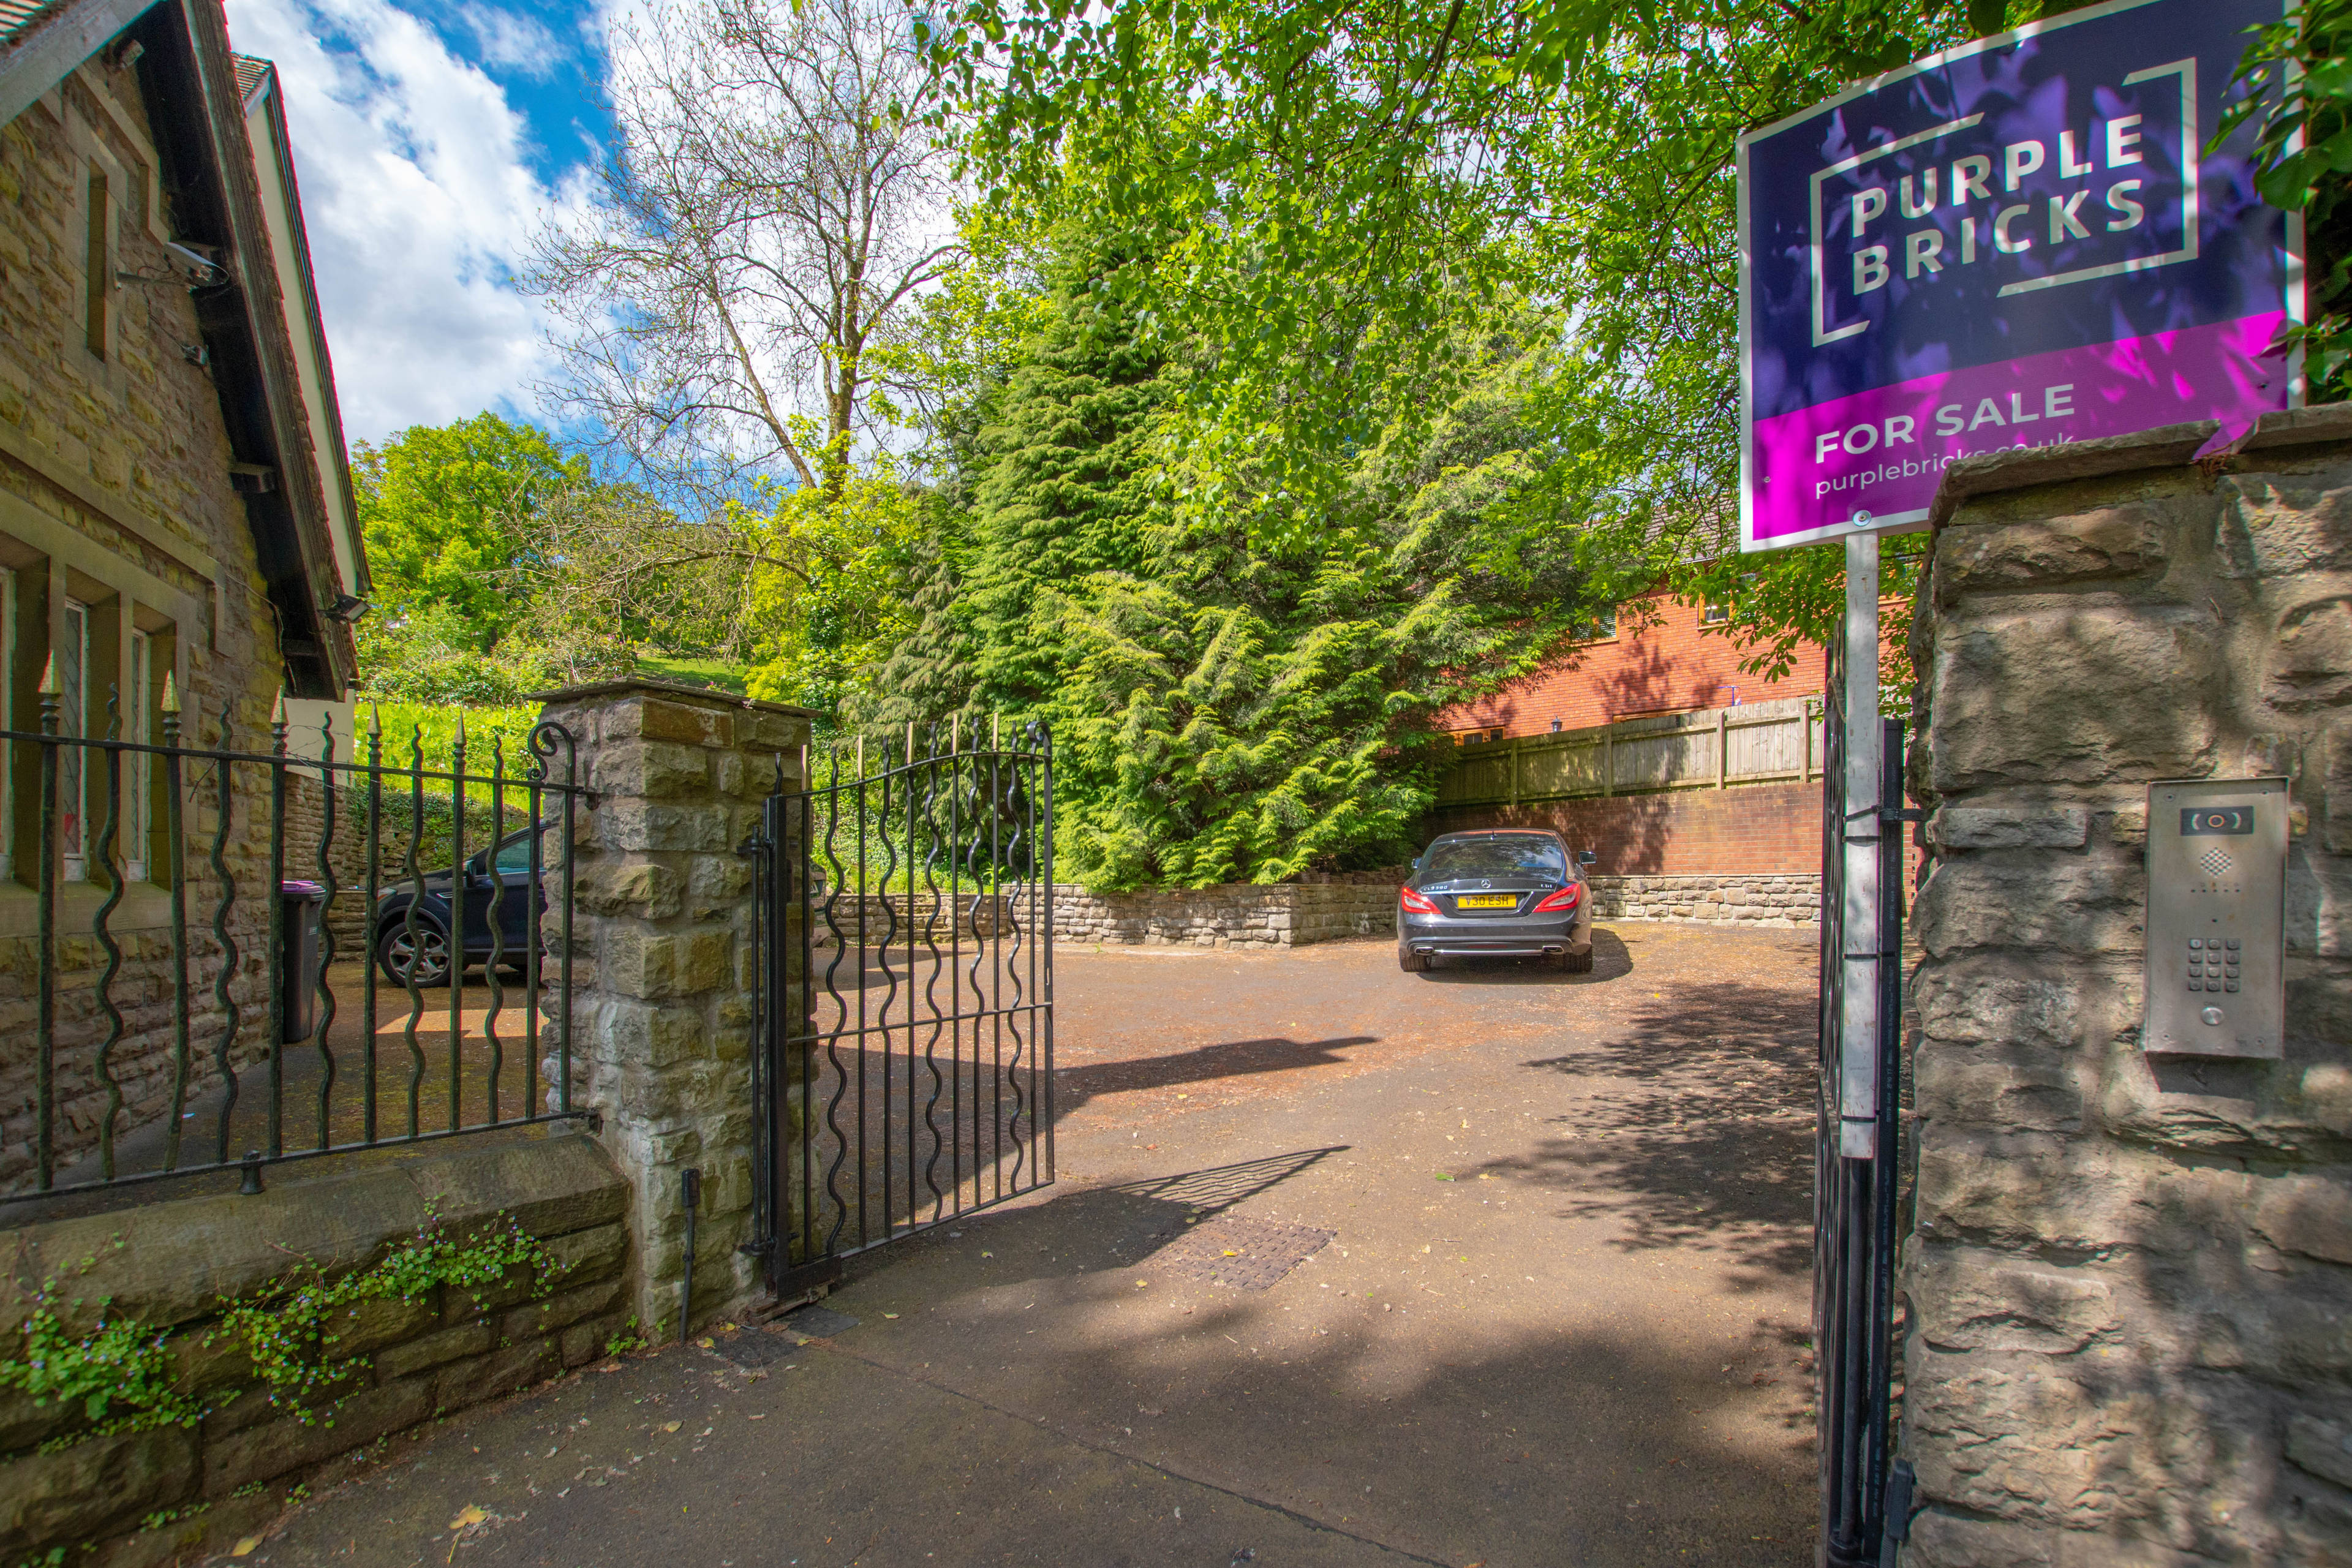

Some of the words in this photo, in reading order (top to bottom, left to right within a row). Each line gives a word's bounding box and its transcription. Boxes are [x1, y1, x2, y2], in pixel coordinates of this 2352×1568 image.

[1852, 114, 2143, 238] PURPLE
[1853, 179, 2144, 295] BRICKS
[1816, 415, 1915, 464] FOR
[1936, 383, 2075, 436] SALE
[1816, 432, 2074, 499] purplebrickk
[1466, 896, 1485, 906] V30
